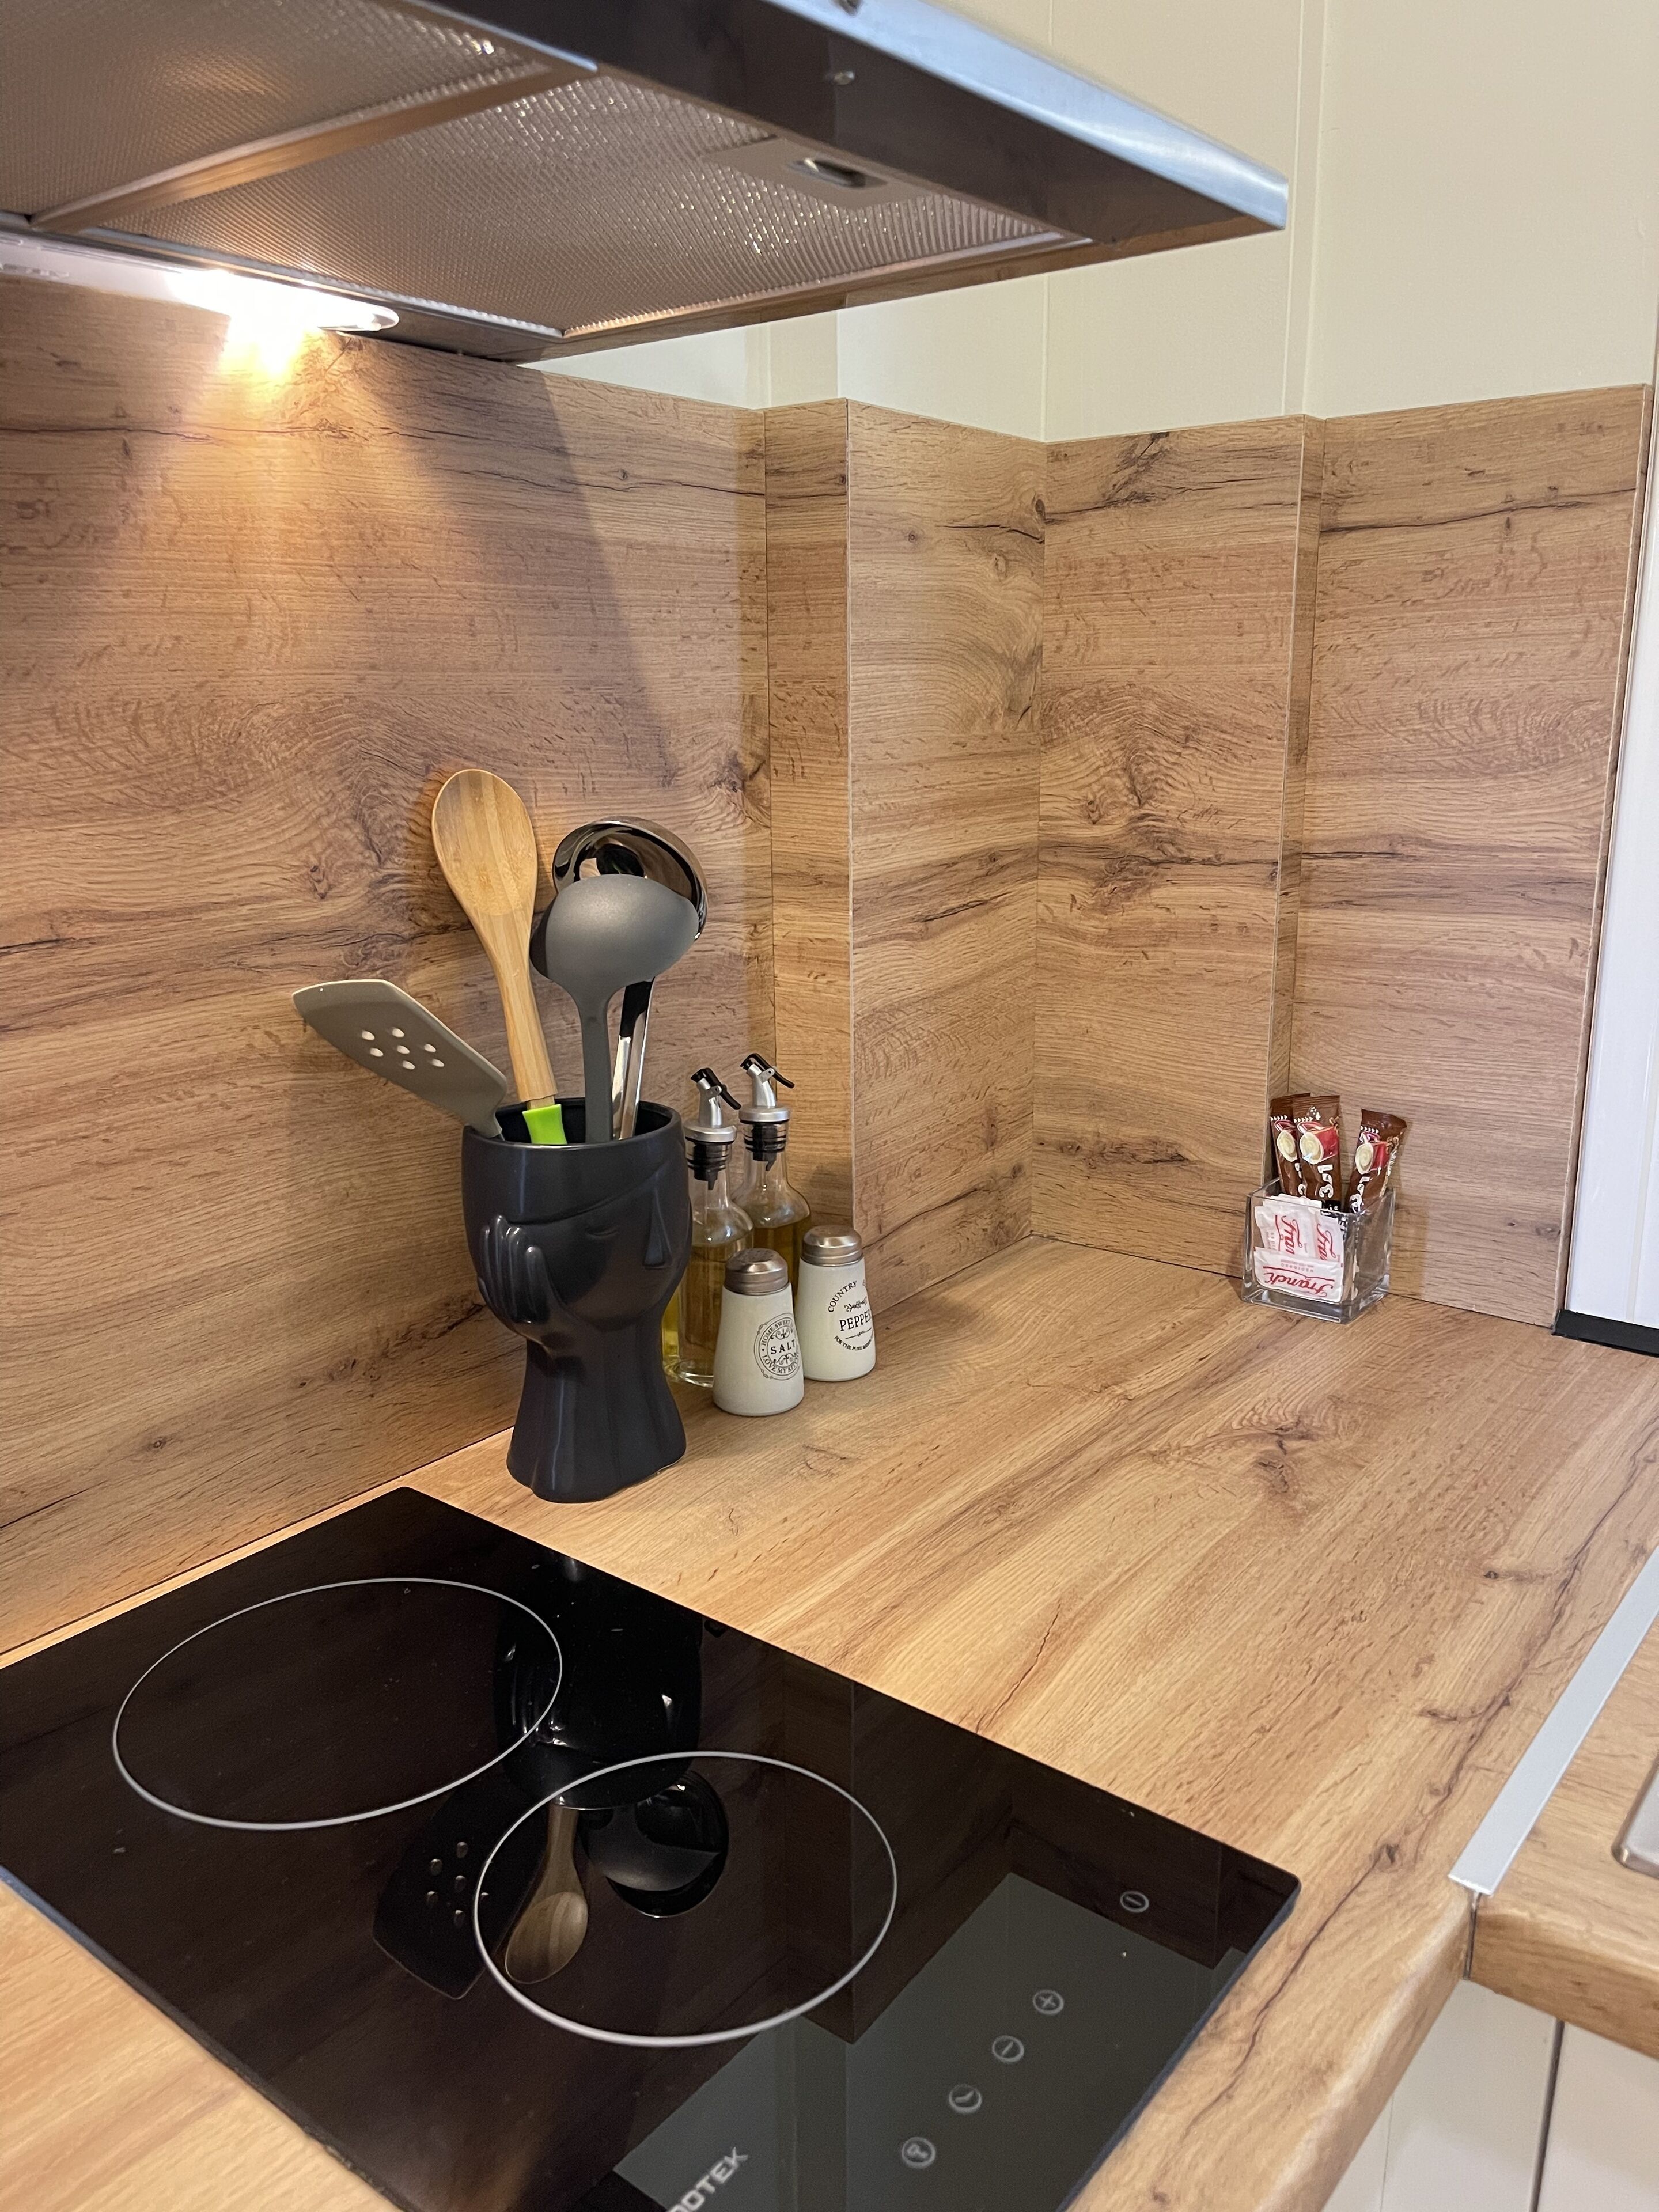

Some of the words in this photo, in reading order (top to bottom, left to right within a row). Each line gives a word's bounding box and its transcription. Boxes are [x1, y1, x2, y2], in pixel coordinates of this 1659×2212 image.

[1263, 1272, 1334, 1298] Franck
[828, 1280, 858, 1313] COUNTRY
[761, 1327, 774, 1346] HOME
[771, 1339, 795, 1355] SALT
